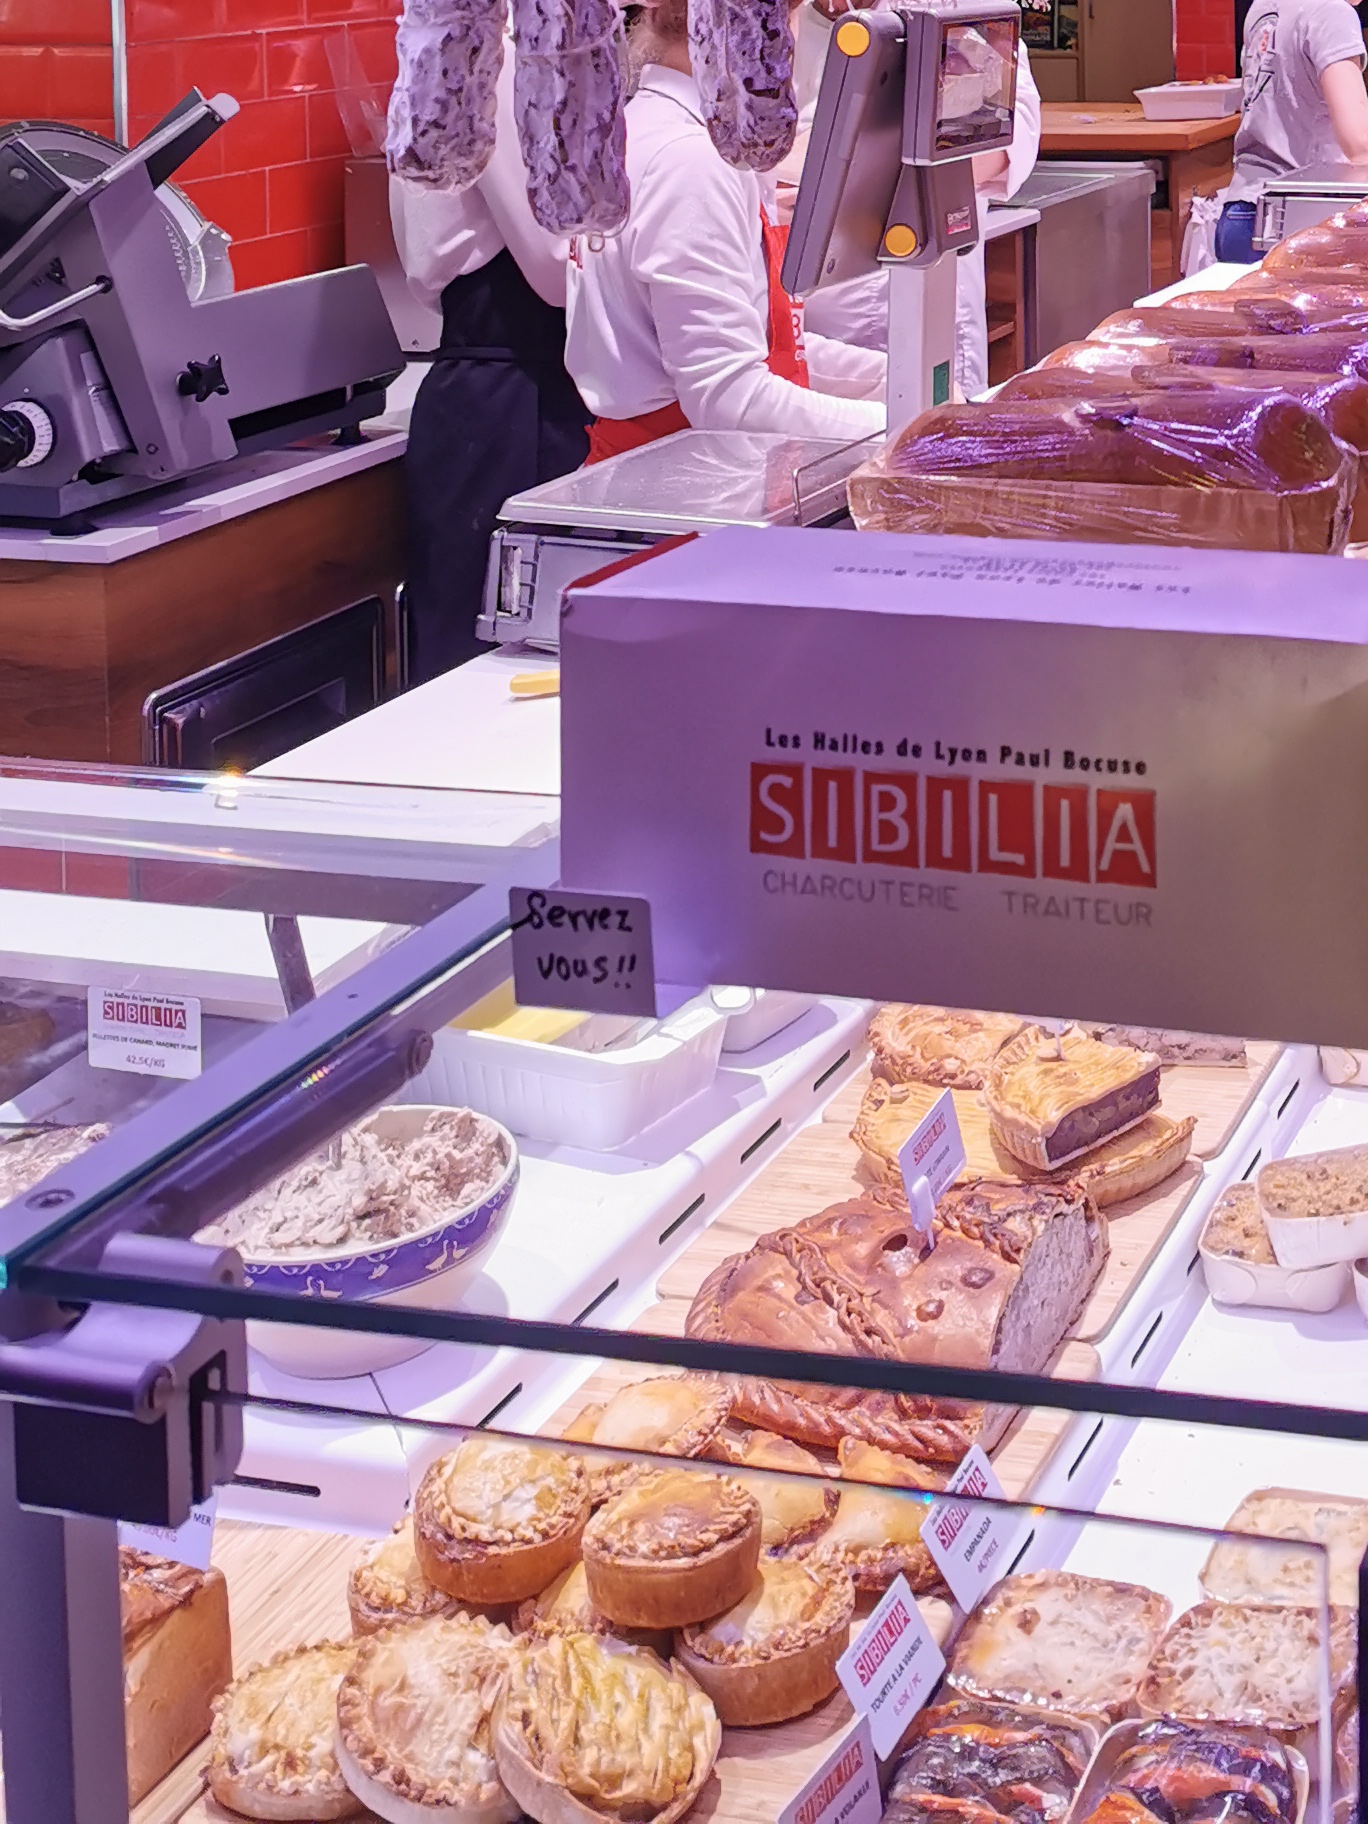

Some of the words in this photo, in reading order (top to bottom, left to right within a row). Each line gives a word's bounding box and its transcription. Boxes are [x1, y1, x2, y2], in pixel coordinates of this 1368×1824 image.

[765, 728, 802, 749] Les
[813, 731, 885, 756] Halles
[896, 738, 923, 759] de
[935, 740, 988, 767] Lyon
[1000, 745, 1050, 769] Paul
[1063, 749, 1148, 776] Bocuse
[756, 771, 1153, 876] SIBILIA
[526, 890, 633, 933] Servez
[762, 868, 960, 912] CHARCUTERIE
[1003, 889, 1154, 928] TRAITEUR
[103, 1001, 186, 1029] SIBILIA
[963, 1516, 992, 1563] EMPANADA
[854, 1598, 911, 1688] SIBILIA
[870, 1676, 893, 1713] TOURTE
